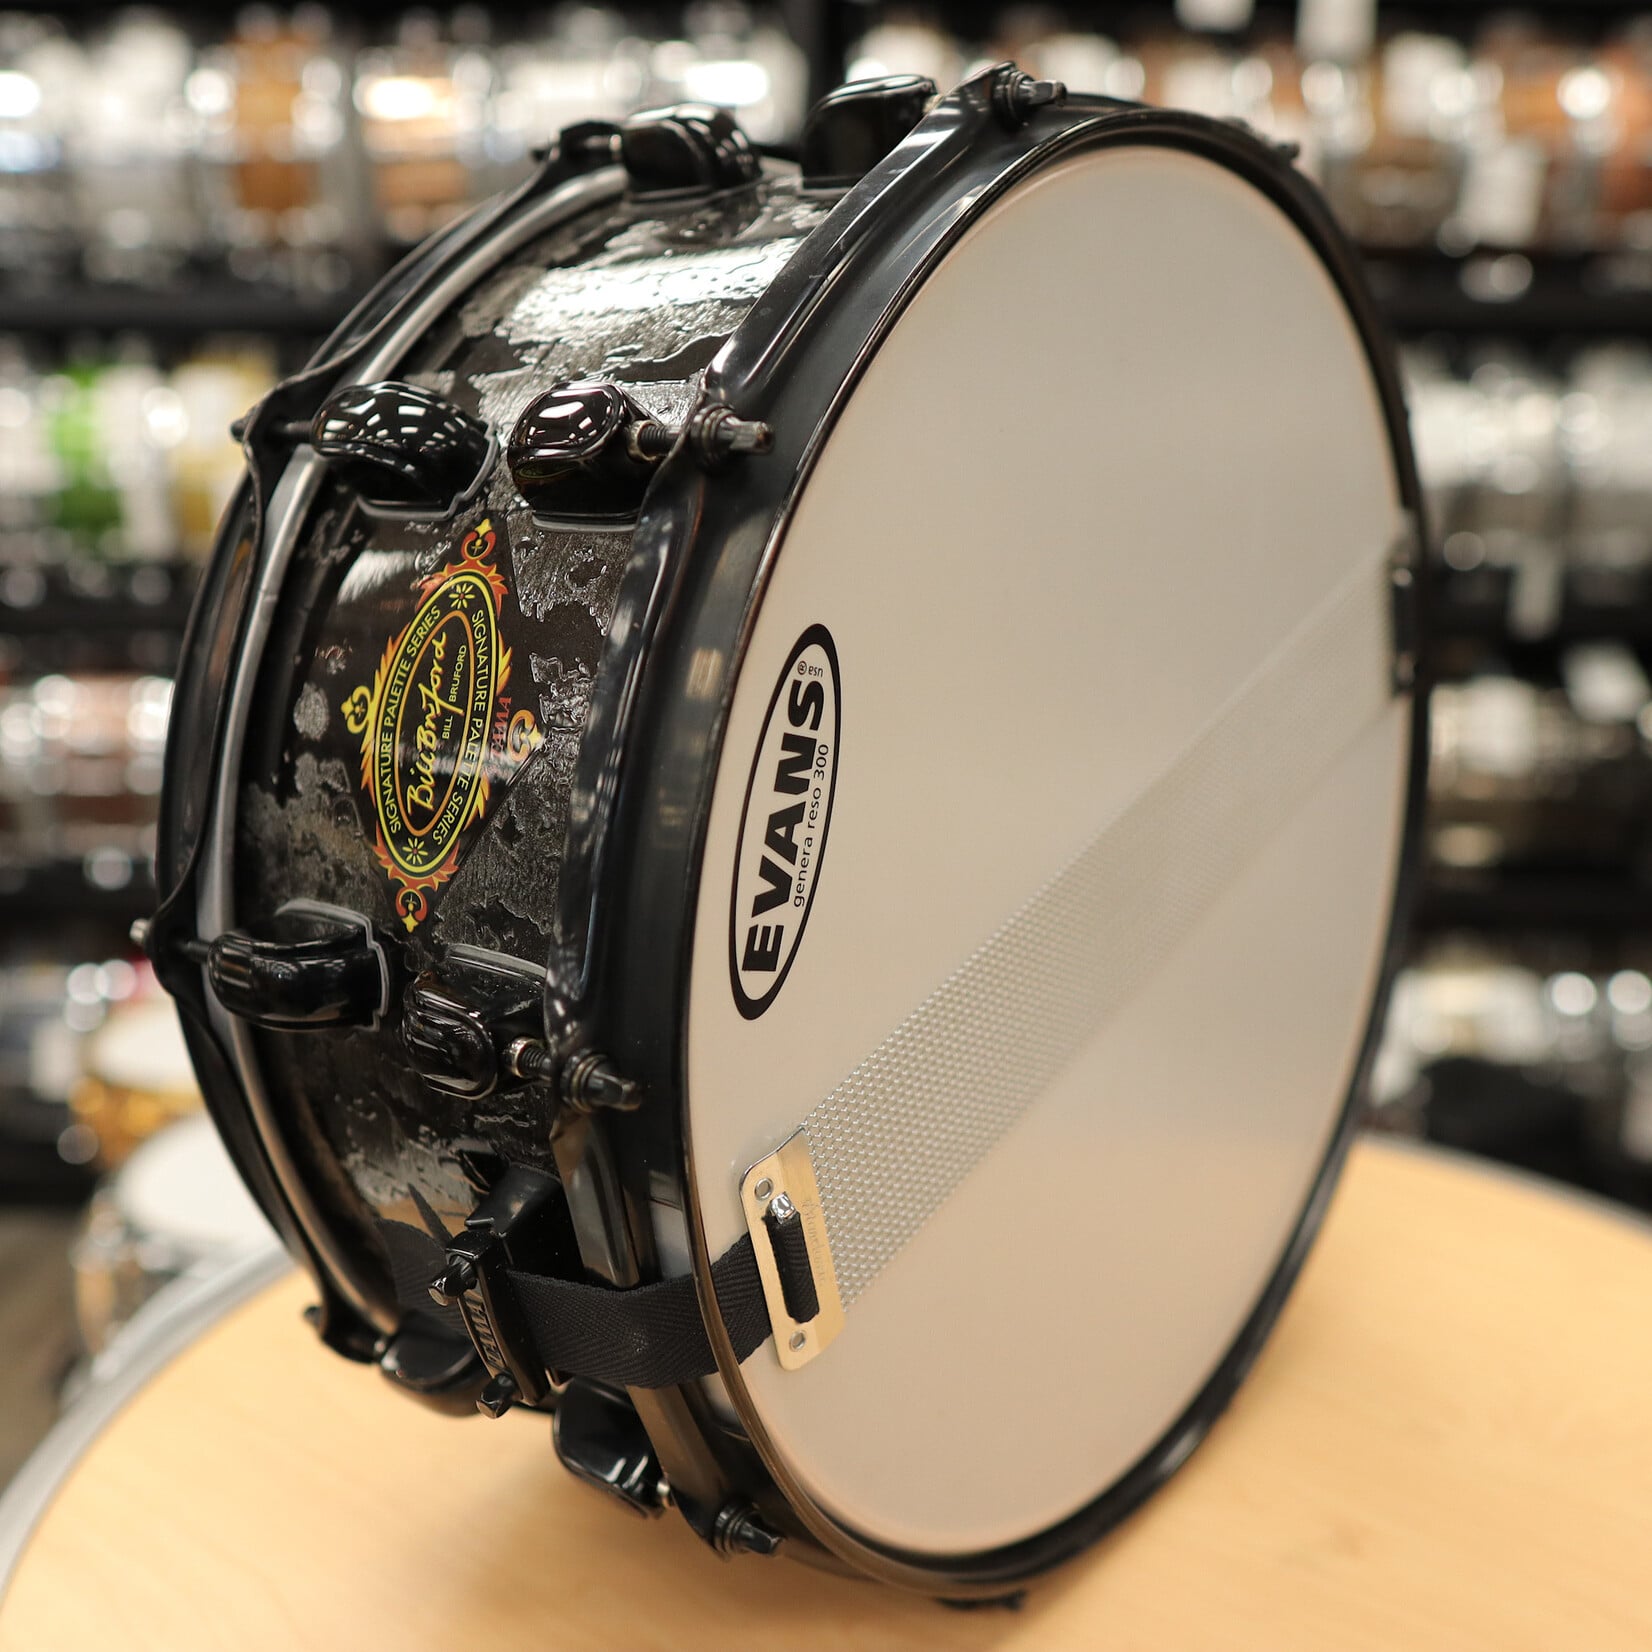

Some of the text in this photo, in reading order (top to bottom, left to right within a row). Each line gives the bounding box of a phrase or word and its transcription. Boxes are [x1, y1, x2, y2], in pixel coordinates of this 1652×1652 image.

[379, 605, 442, 834] SIGNATURE PALETTE SERIES
[432, 609, 489, 845] SIGNATURE PALETTE SERIES
[441, 644, 467, 740] BILL BRUFORD
[490, 697, 512, 758] TAMA
[741, 679, 824, 972] EVANS
[793, 744, 829, 908] genera reso 300
